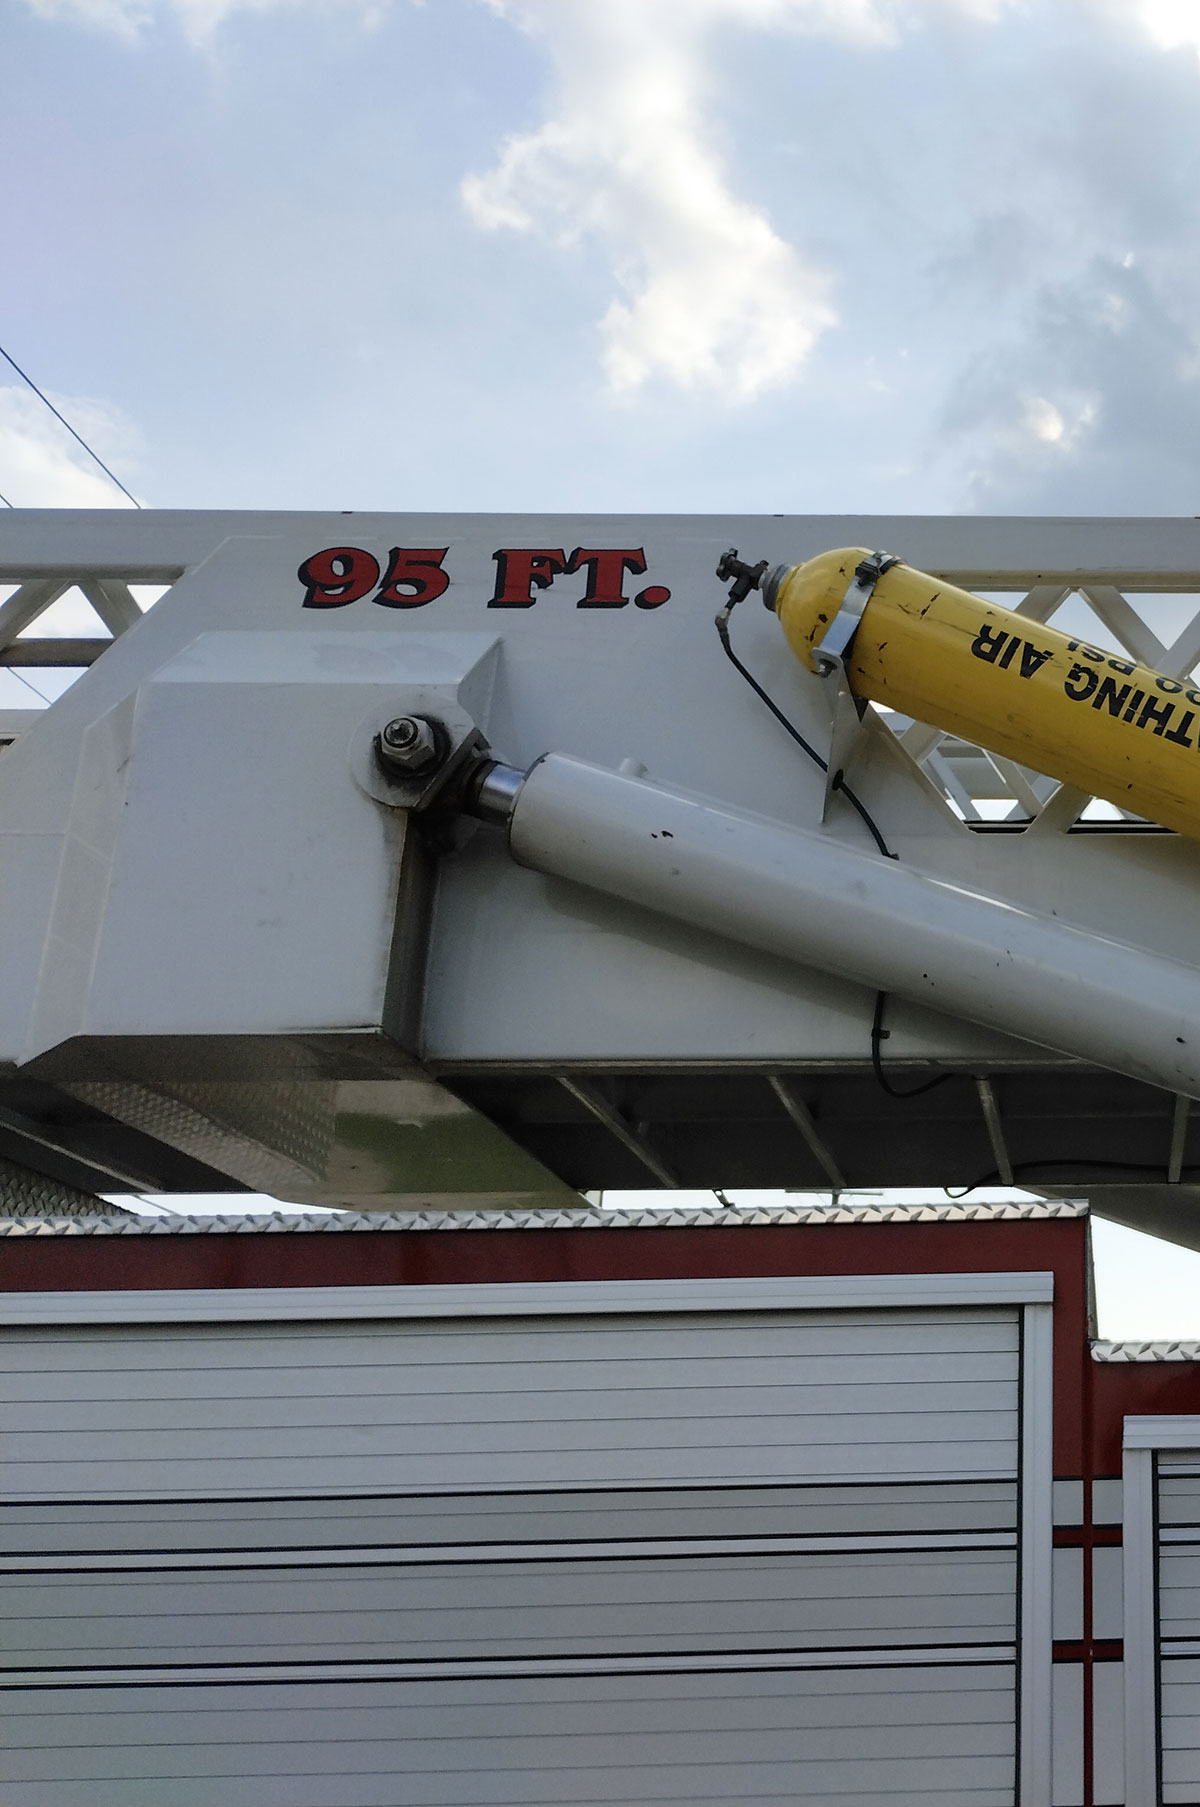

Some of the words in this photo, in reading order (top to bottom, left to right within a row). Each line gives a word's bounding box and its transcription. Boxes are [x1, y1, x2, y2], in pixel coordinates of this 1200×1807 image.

[297, 546, 450, 609] 95
[487, 546, 672, 609] FT.
[970, 623, 1054, 680] AIR
[1065, 641, 1138, 676] PSI
